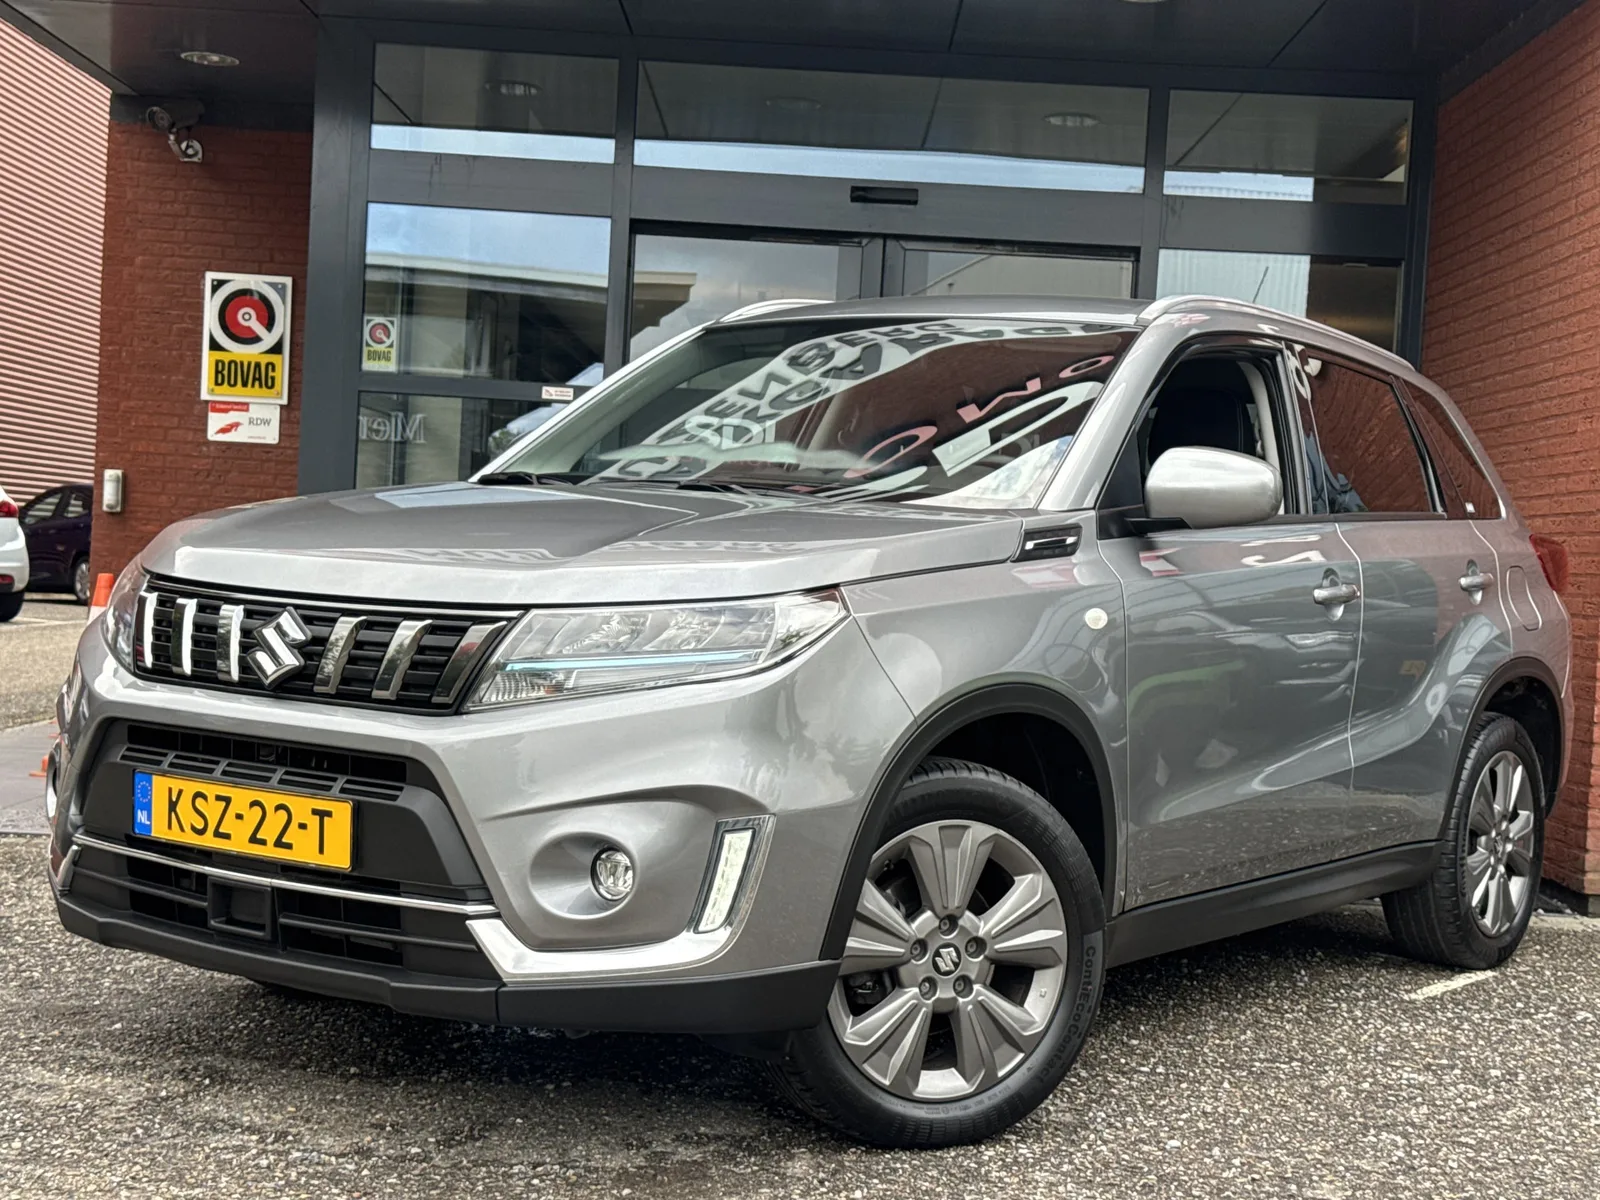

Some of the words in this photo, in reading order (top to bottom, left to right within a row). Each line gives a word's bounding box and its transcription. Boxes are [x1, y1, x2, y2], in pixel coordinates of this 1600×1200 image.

[367, 348, 392, 362] BOVAG
[214, 359, 276, 390] BOVAG
[248, 417, 272, 427] RDW
[137, 809, 150, 825] NL
[167, 786, 333, 855] KSZ-22-T
[1039, 945, 1096, 1084] ContiEcoContact
